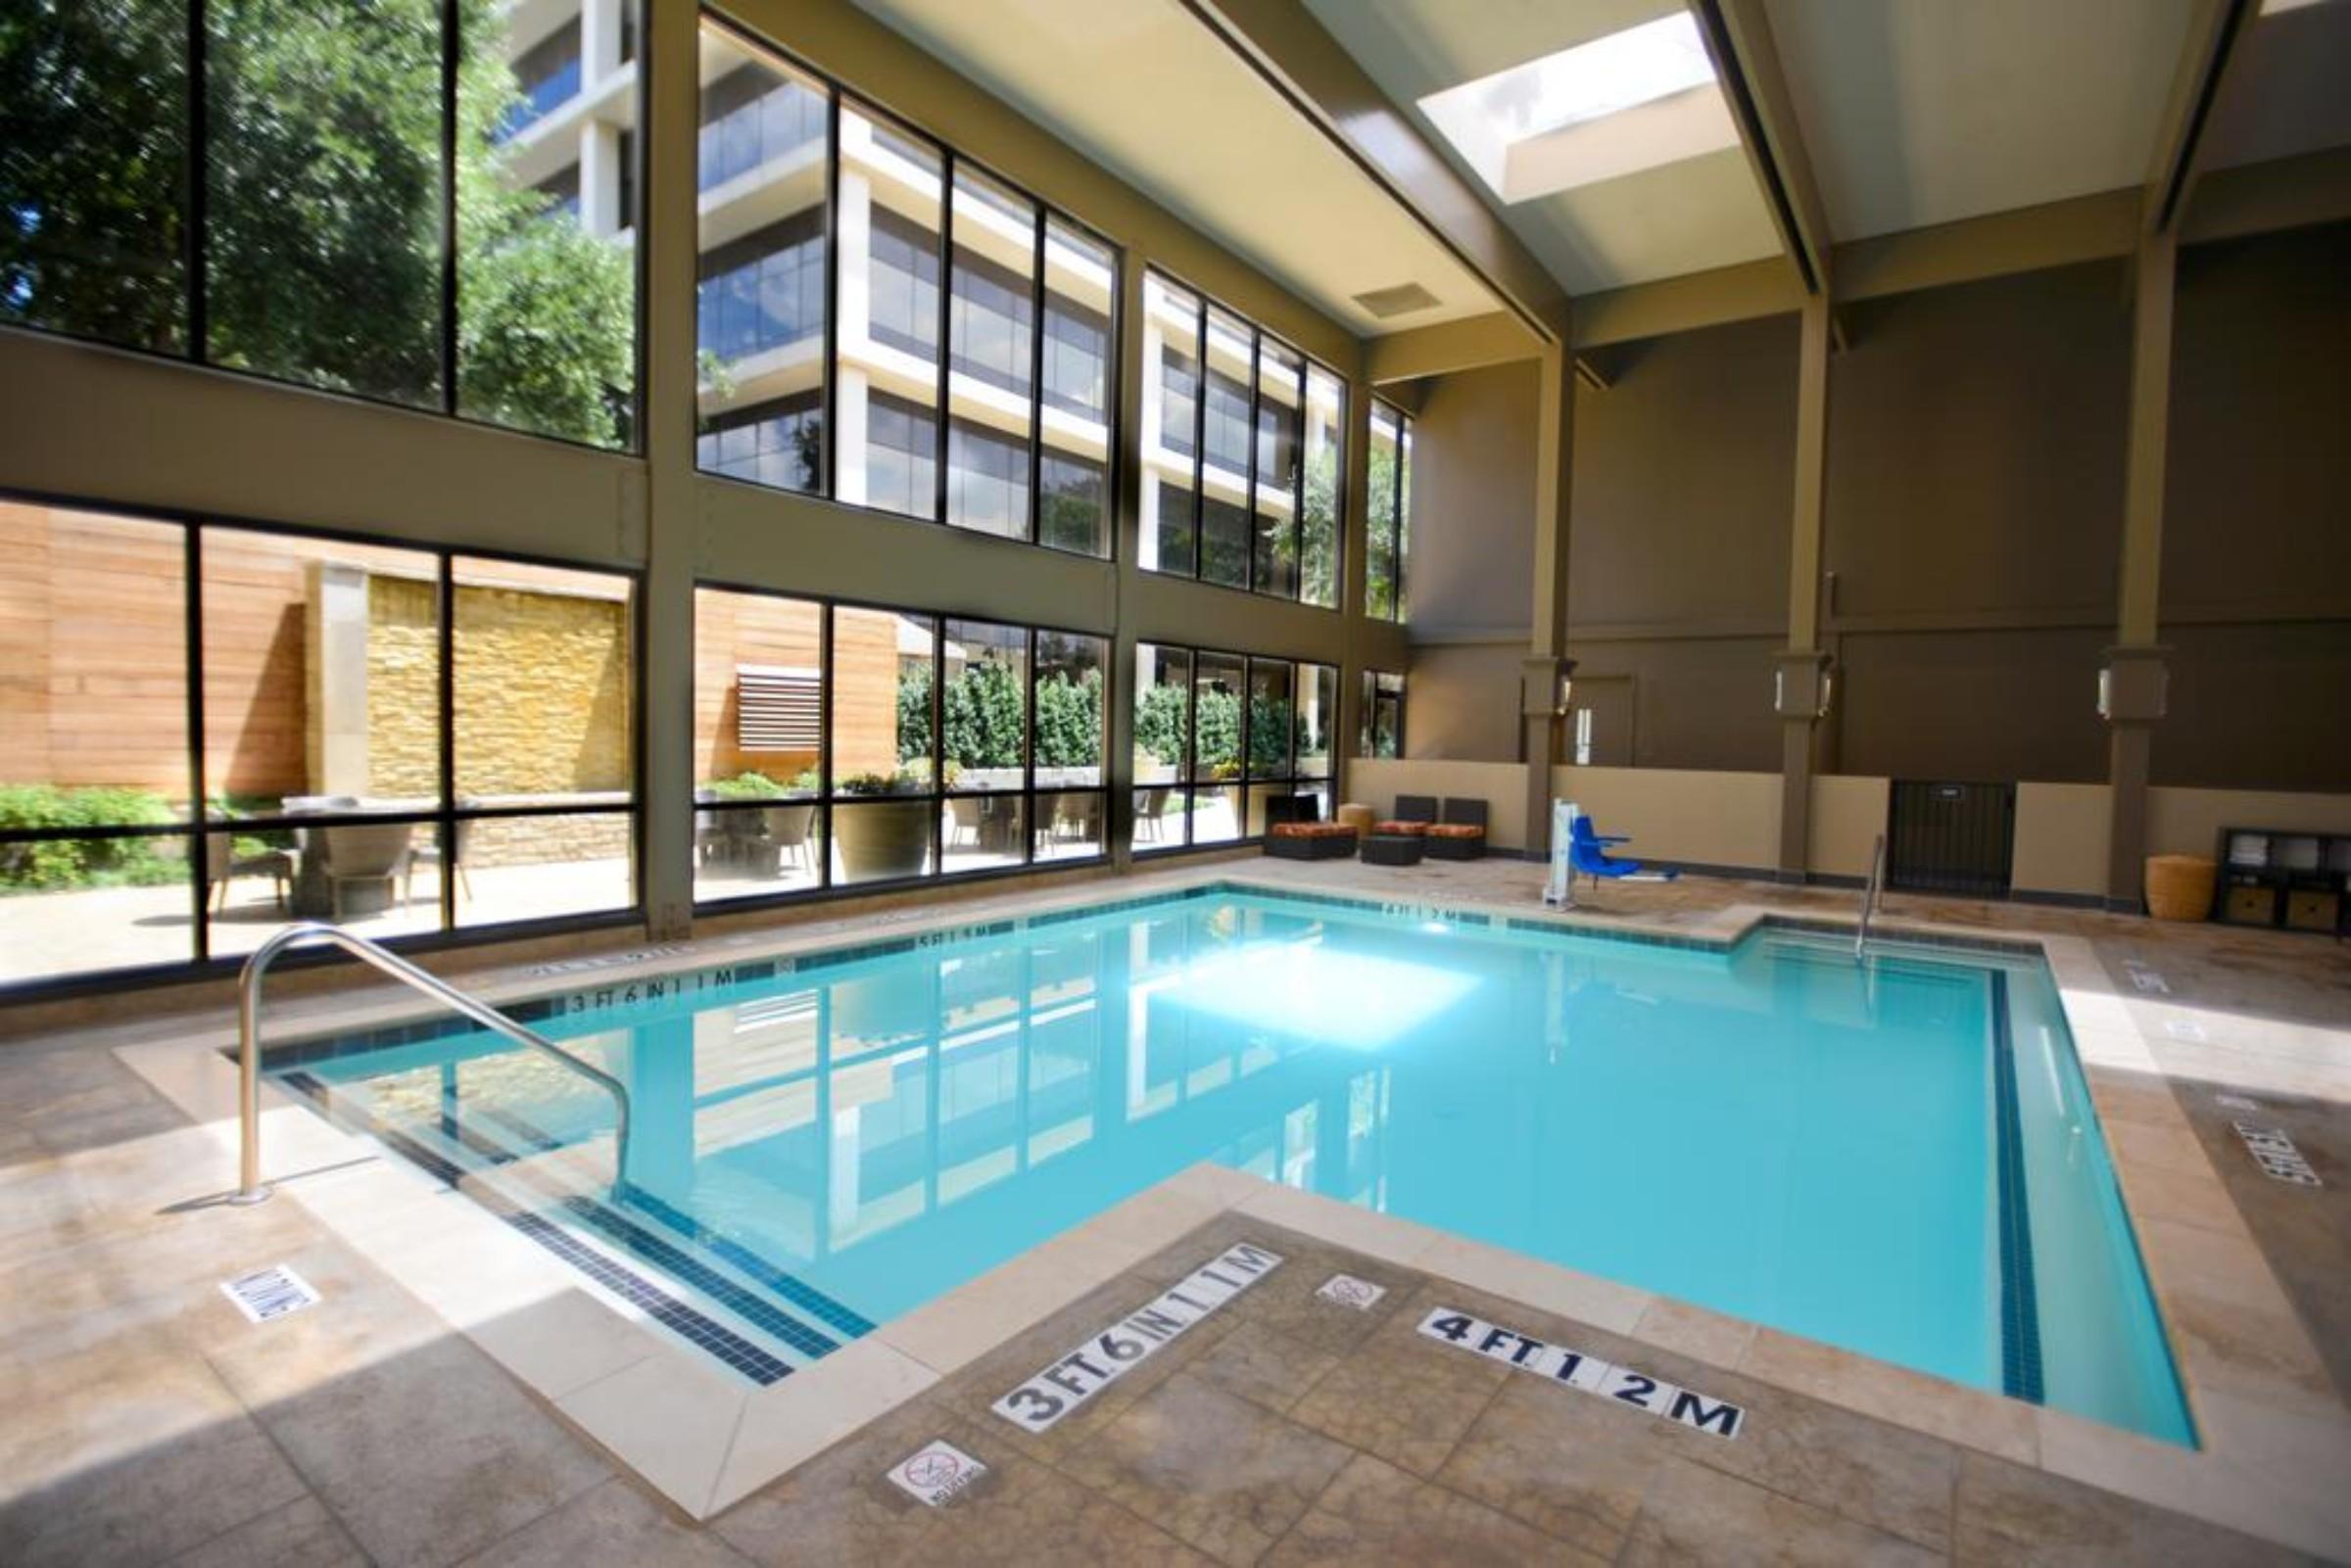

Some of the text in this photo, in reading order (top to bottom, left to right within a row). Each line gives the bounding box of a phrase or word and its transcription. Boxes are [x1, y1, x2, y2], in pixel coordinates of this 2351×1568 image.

[571, 994, 585, 1014] 3
[596, 989, 614, 1009] FT
[624, 984, 638, 1004] 6
[646, 980, 665, 999] IN
[713, 969, 733, 987] M
[1006, 1387, 1065, 1421] 3
[1098, 1333, 1145, 1362] 6
[1224, 1244, 1269, 1274] M
[1431, 1314, 1473, 1342] 4
[1669, 1390, 1742, 1438] M
